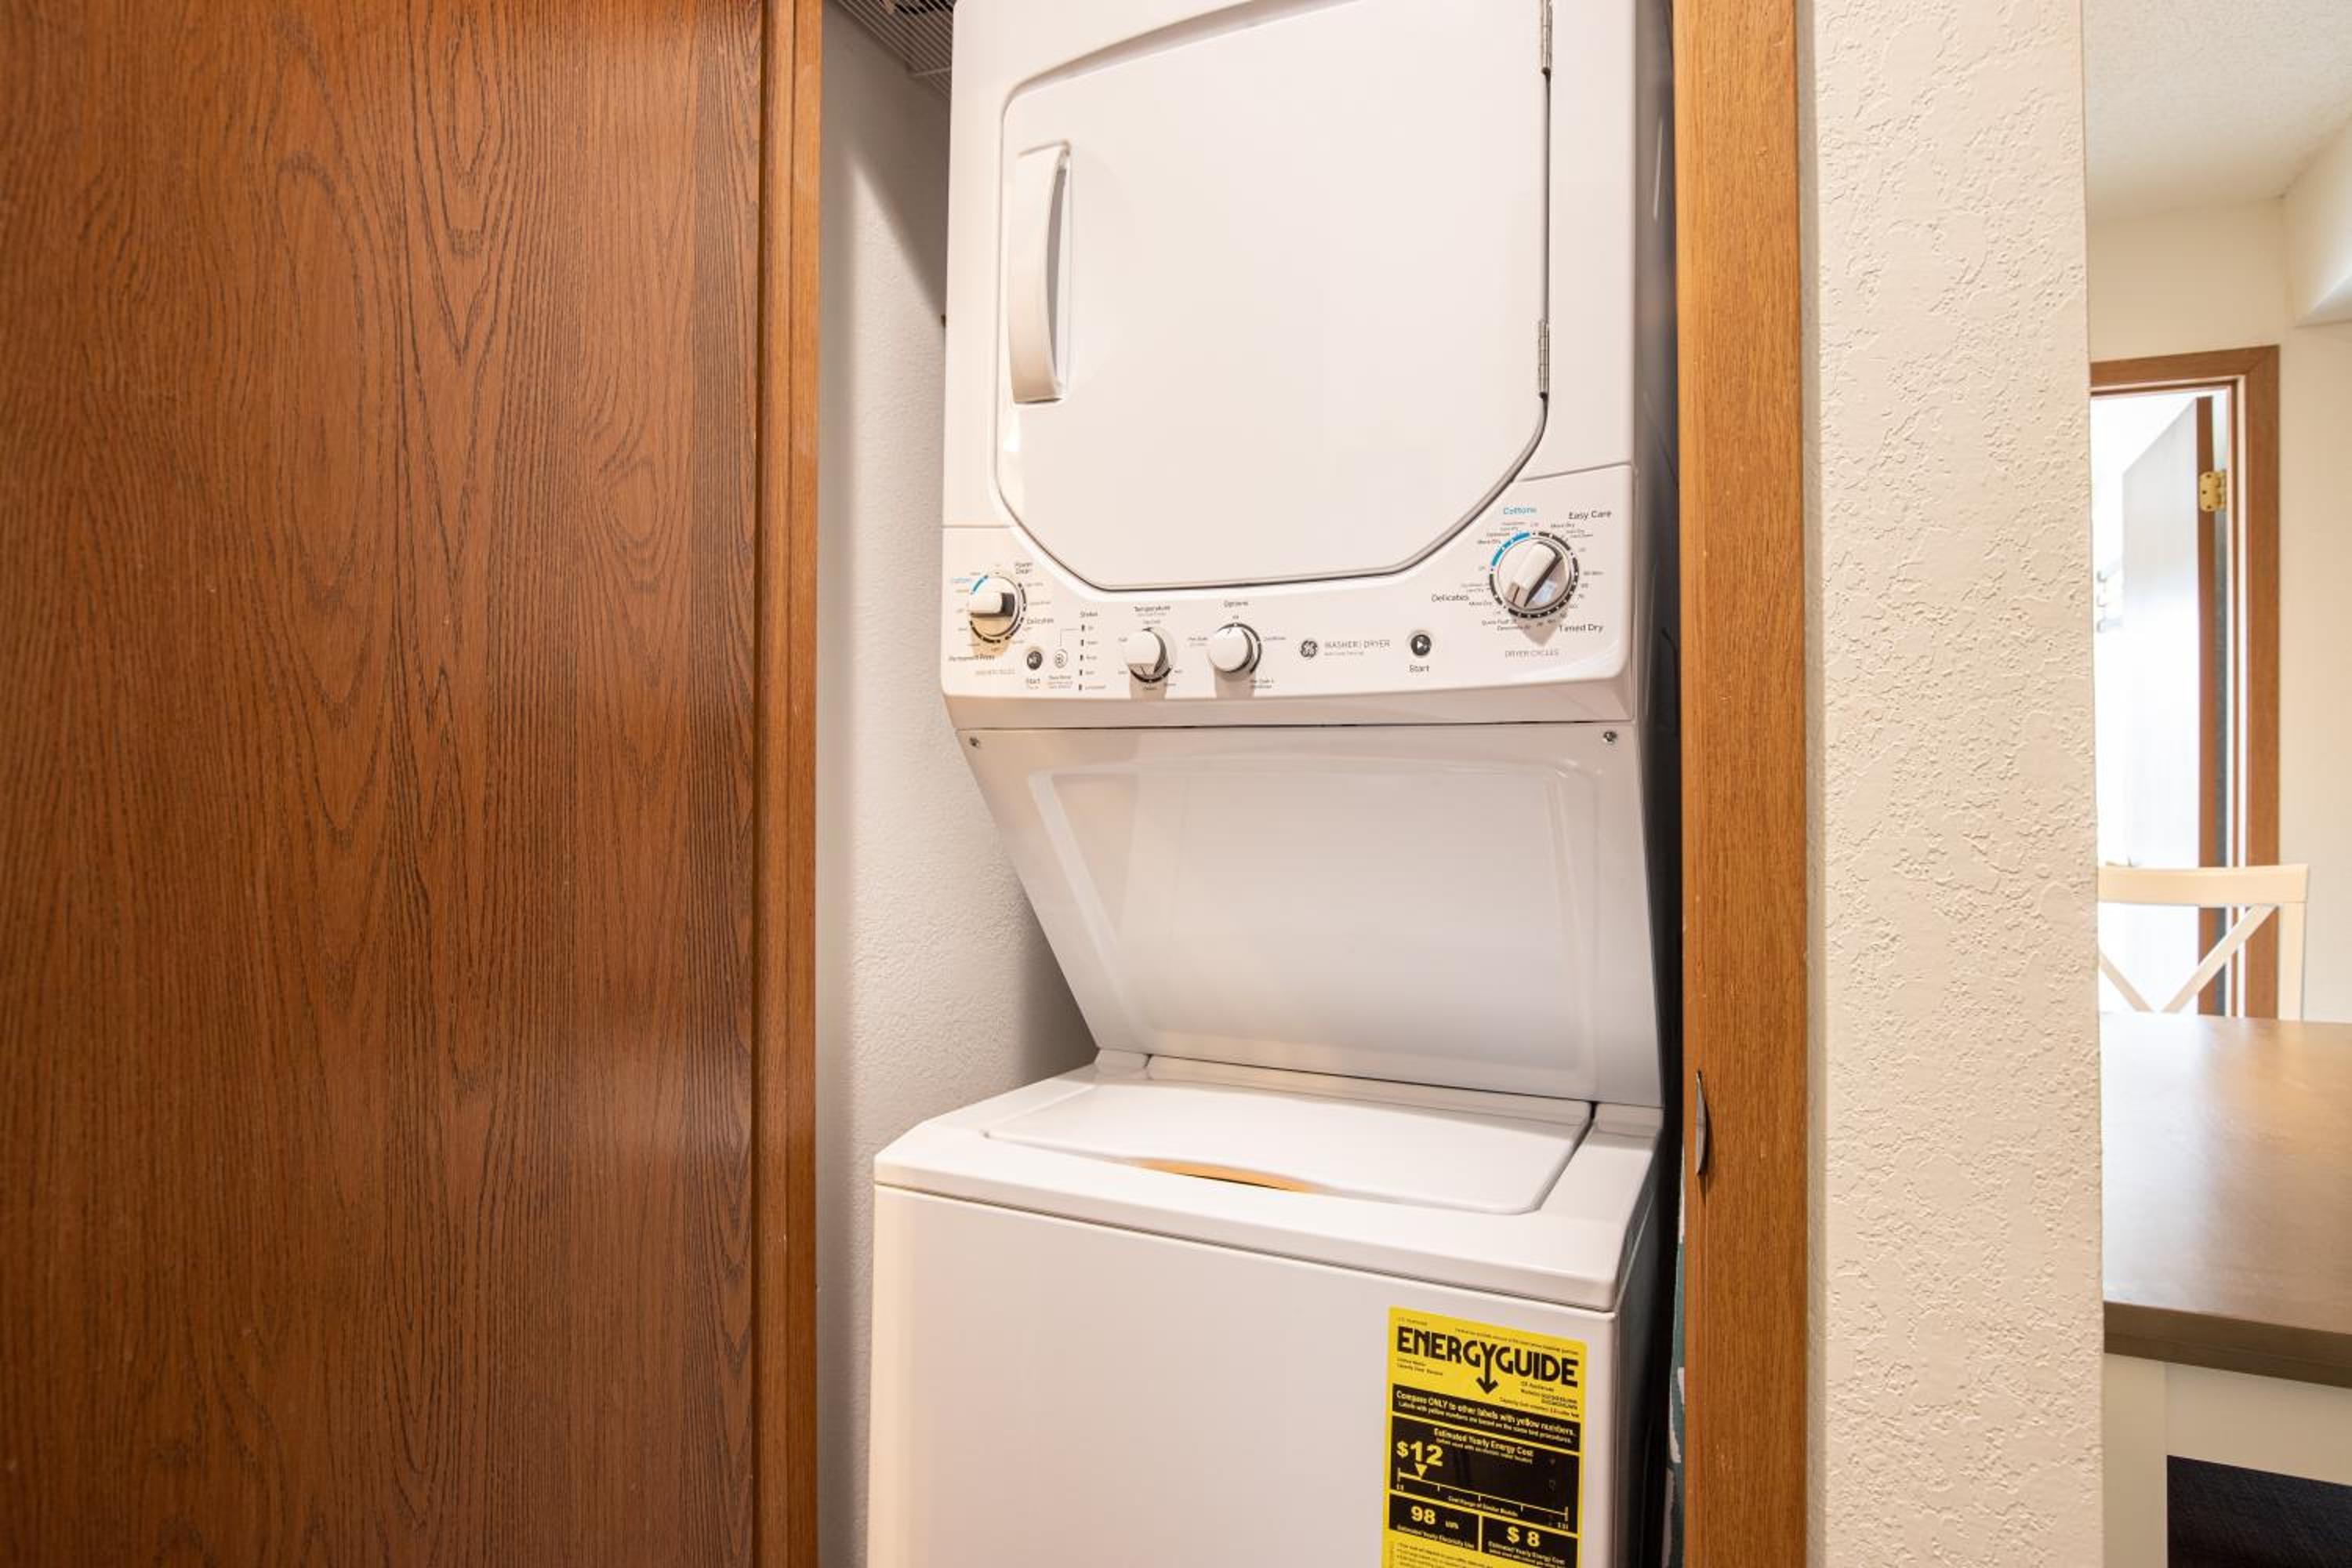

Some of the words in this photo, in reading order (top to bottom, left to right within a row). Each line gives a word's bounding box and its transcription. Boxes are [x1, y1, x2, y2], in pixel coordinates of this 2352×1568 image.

[1568, 512, 1588, 521] Easy
[1588, 623, 1603, 633] Dry
[1364, 639, 1390, 648] DRYER
[1409, 664, 1430, 673] Start
[1396, 1325, 1579, 1388] ENERGYGUIDE
[1428, 1397, 1448, 1409] ONLY
[1500, 1413, 1515, 1423] with
[1516, 1417, 1540, 1428] yellow
[1396, 1440, 1443, 1467] $12
[1490, 1440, 1515, 1454] Energy
[1516, 1446, 1534, 1457] Cost
[1411, 1505, 1436, 1525] 98
[1527, 1530, 1541, 1547] 8
